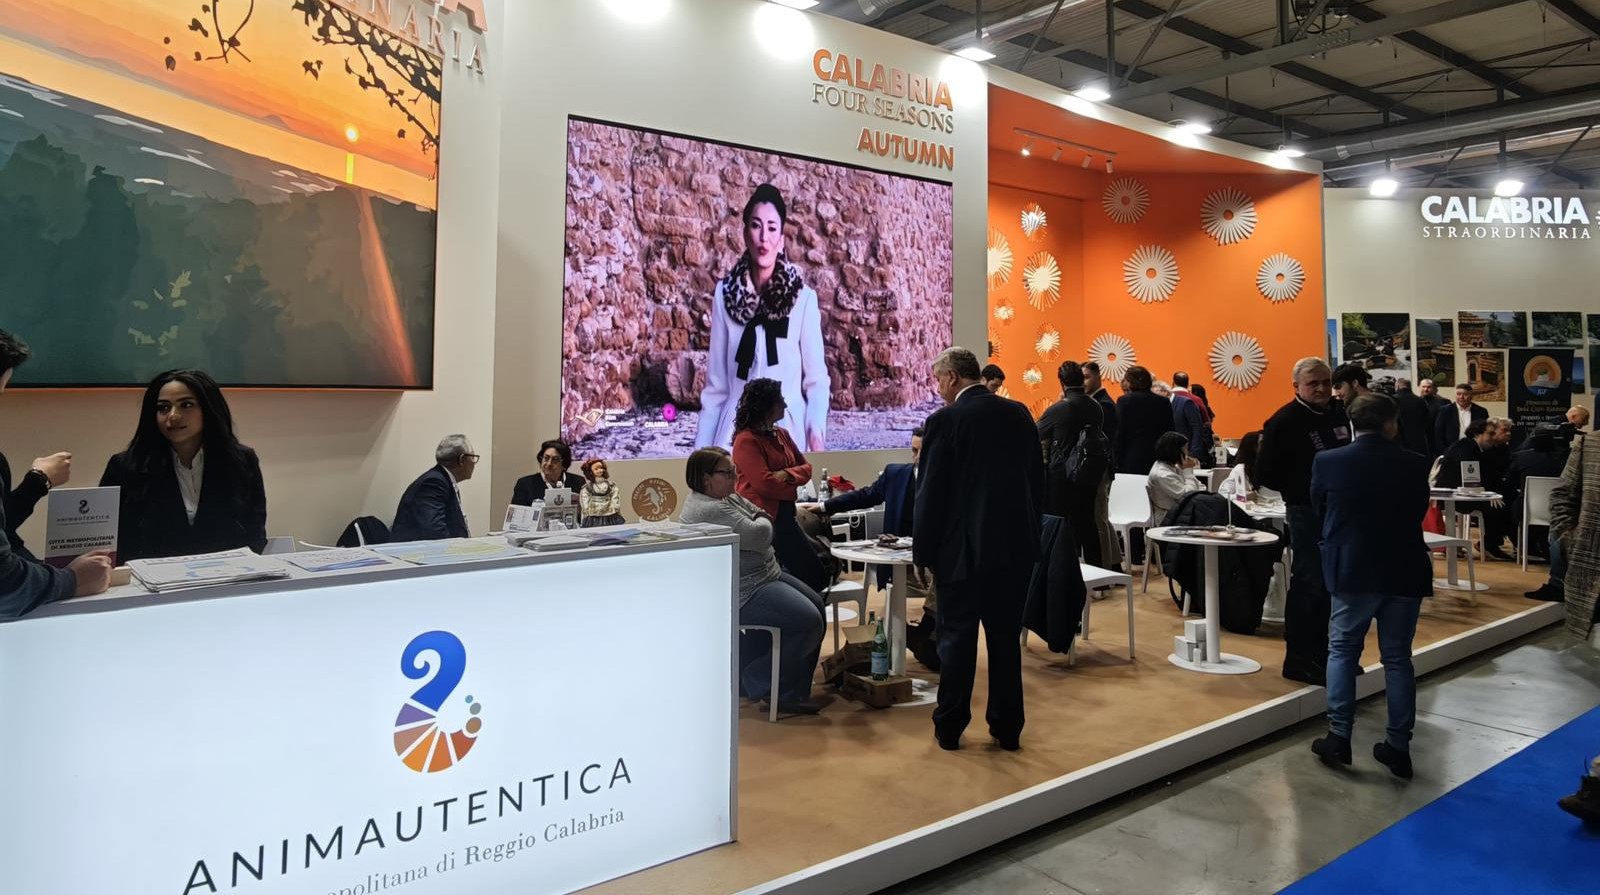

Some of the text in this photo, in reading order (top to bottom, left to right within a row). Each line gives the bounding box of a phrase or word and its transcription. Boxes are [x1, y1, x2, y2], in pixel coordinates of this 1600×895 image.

[346, 0, 484, 74] NARIA
[812, 48, 954, 112] CALABRIA
[812, 82, 954, 134] FOUR SEASONS
[857, 127, 954, 171] AUTUMN
[1421, 195, 1590, 225] CALABRIA
[1423, 226, 1591, 239] STRAORDINARIA
[183, 757, 632, 895] ANIMAUTENTICA
[436, 852, 455, 873] di
[464, 832, 536, 866] Reggio
[544, 807, 625, 842] Calabria
